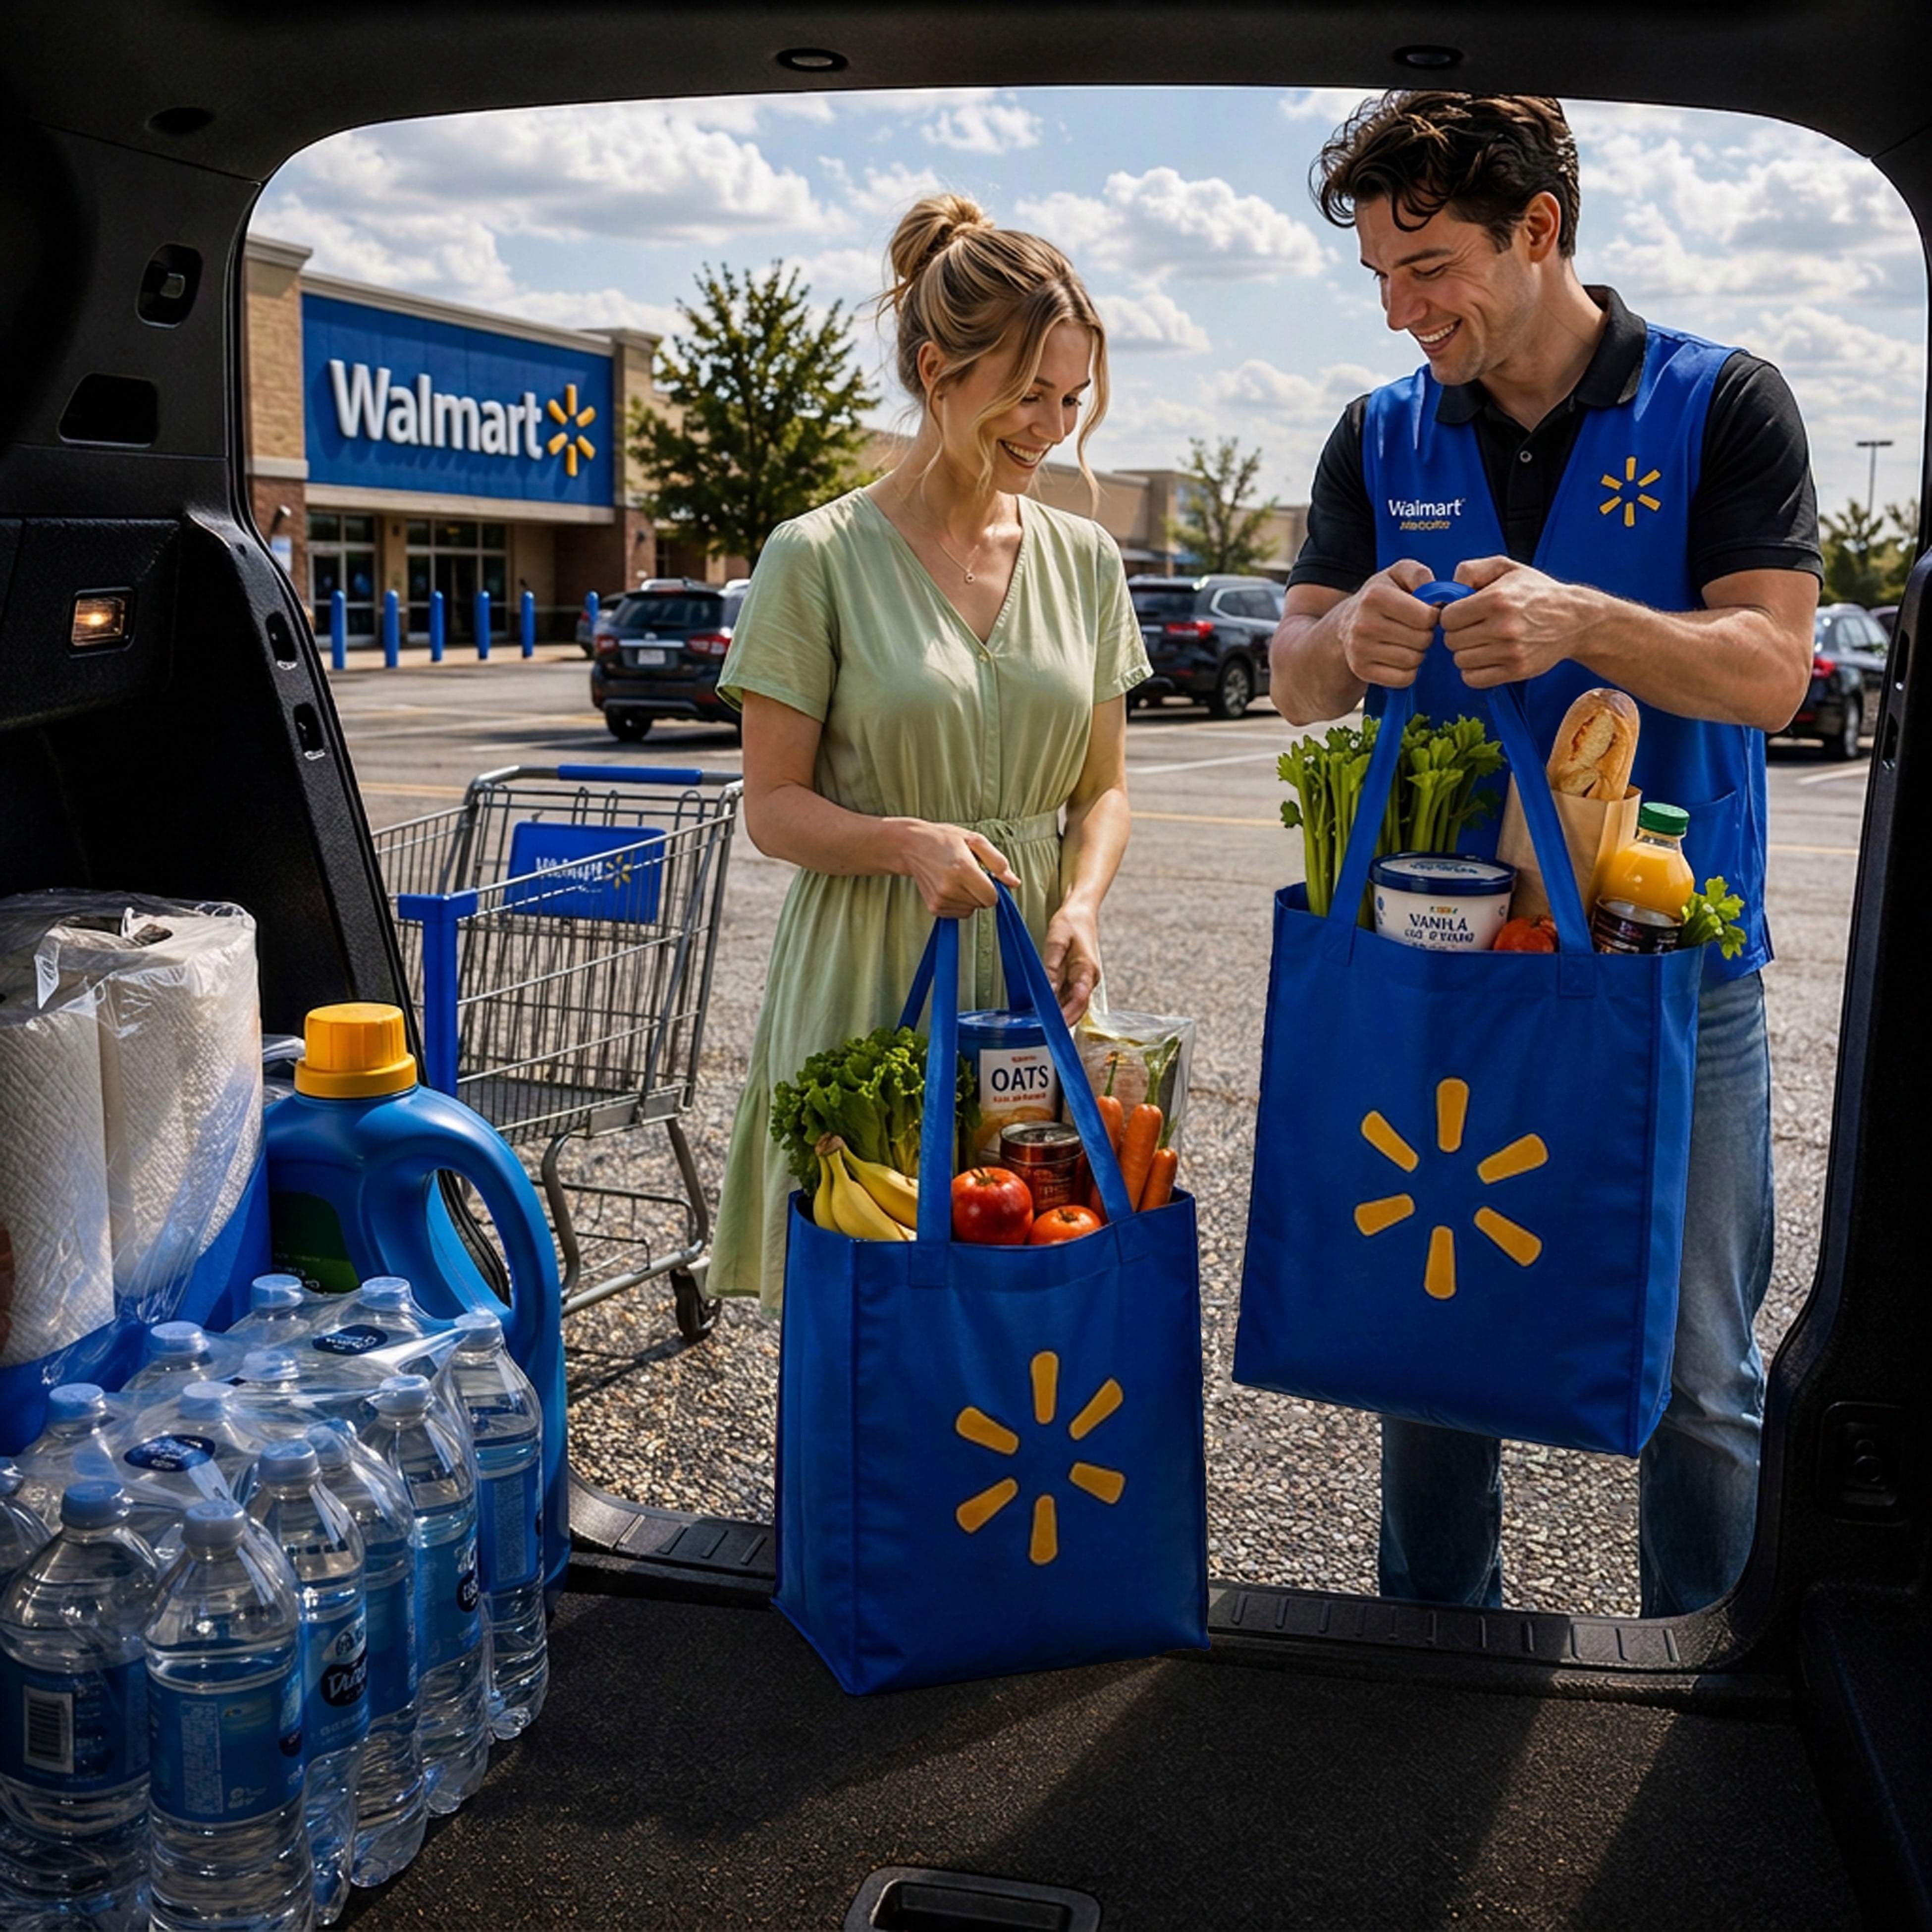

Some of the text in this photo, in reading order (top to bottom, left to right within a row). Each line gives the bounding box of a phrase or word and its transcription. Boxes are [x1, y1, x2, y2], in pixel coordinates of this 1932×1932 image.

[329, 359, 543, 461] Walmart
[1388, 499, 1462, 516] Walmart
[991, 1065, 1049, 1092] OATS
